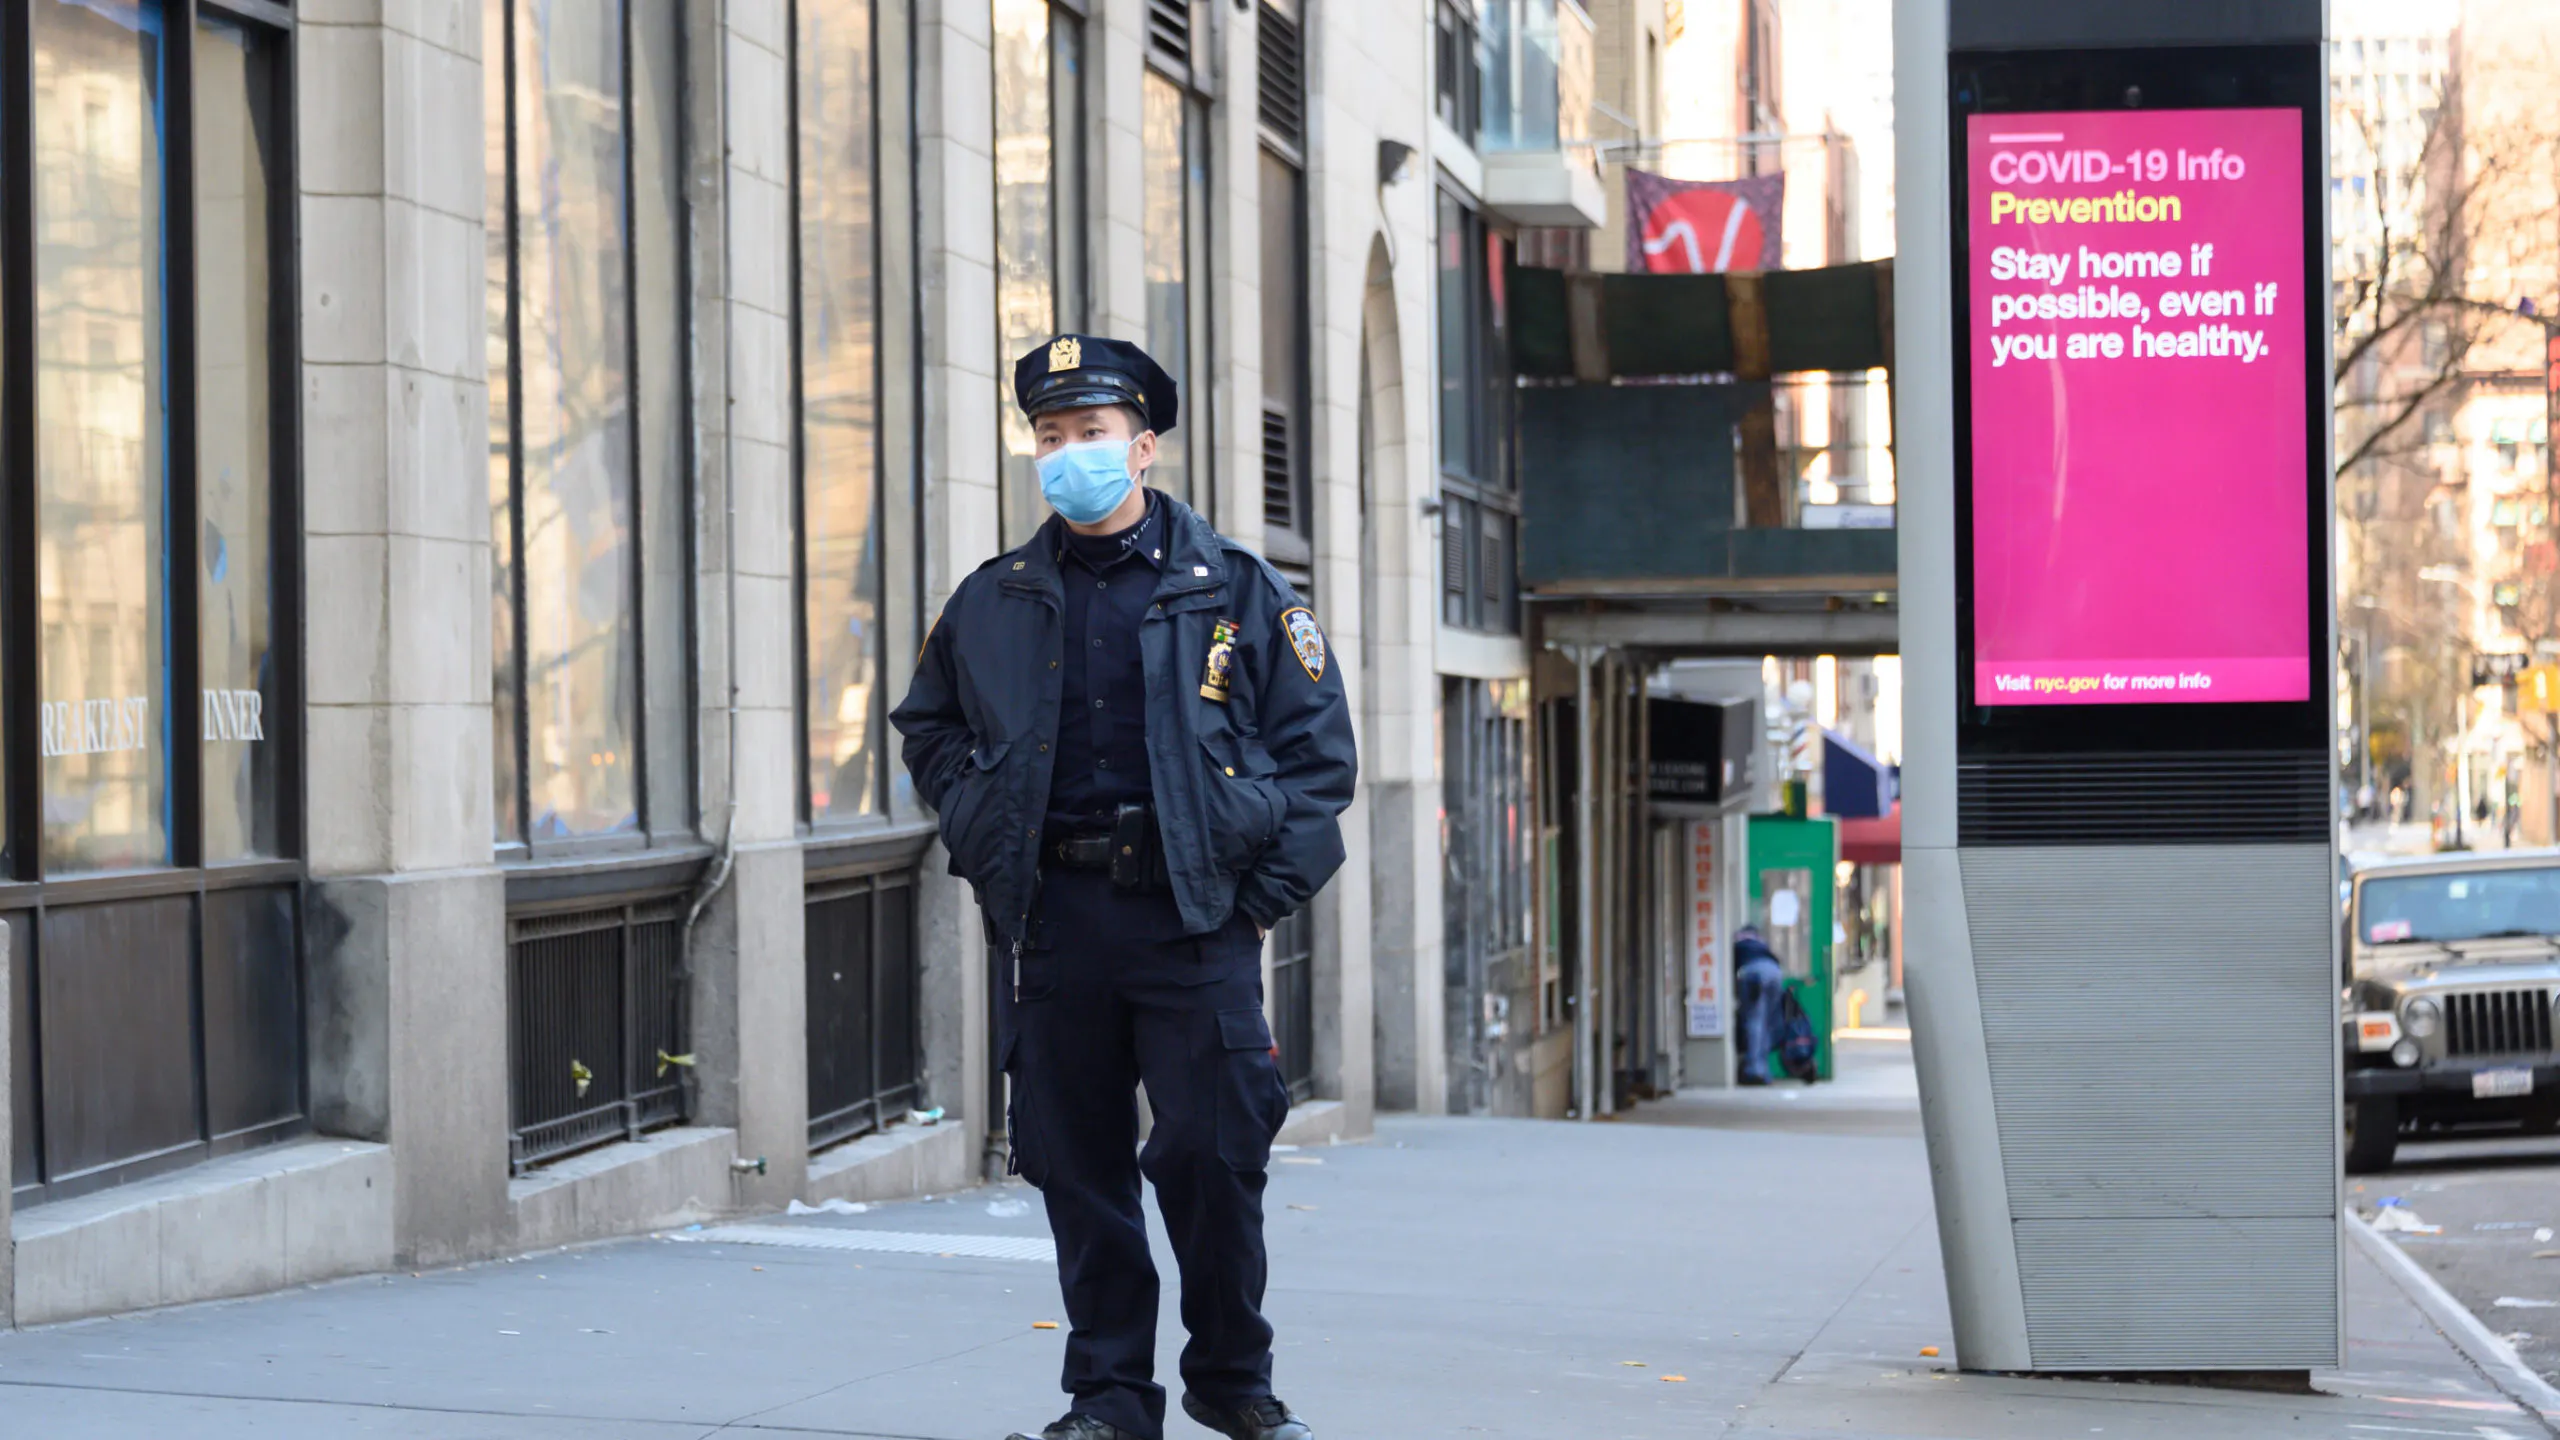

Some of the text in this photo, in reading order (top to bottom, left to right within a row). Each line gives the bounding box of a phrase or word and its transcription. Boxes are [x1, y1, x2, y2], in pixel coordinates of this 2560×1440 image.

[1990, 147, 2245, 184] COVID-19 Info
[1990, 189, 2181, 224] Prevention
[1990, 243, 2214, 286] Stay home if
[1991, 282, 2278, 327] possible, even if
[1991, 324, 2269, 367] you are healthy.
[1995, 671, 2211, 693] Visit nyc.gov for more info
[42, 696, 148, 757] REAKFAST
[203, 689, 265, 741] INNER
[1694, 825, 1712, 892] SHOE
